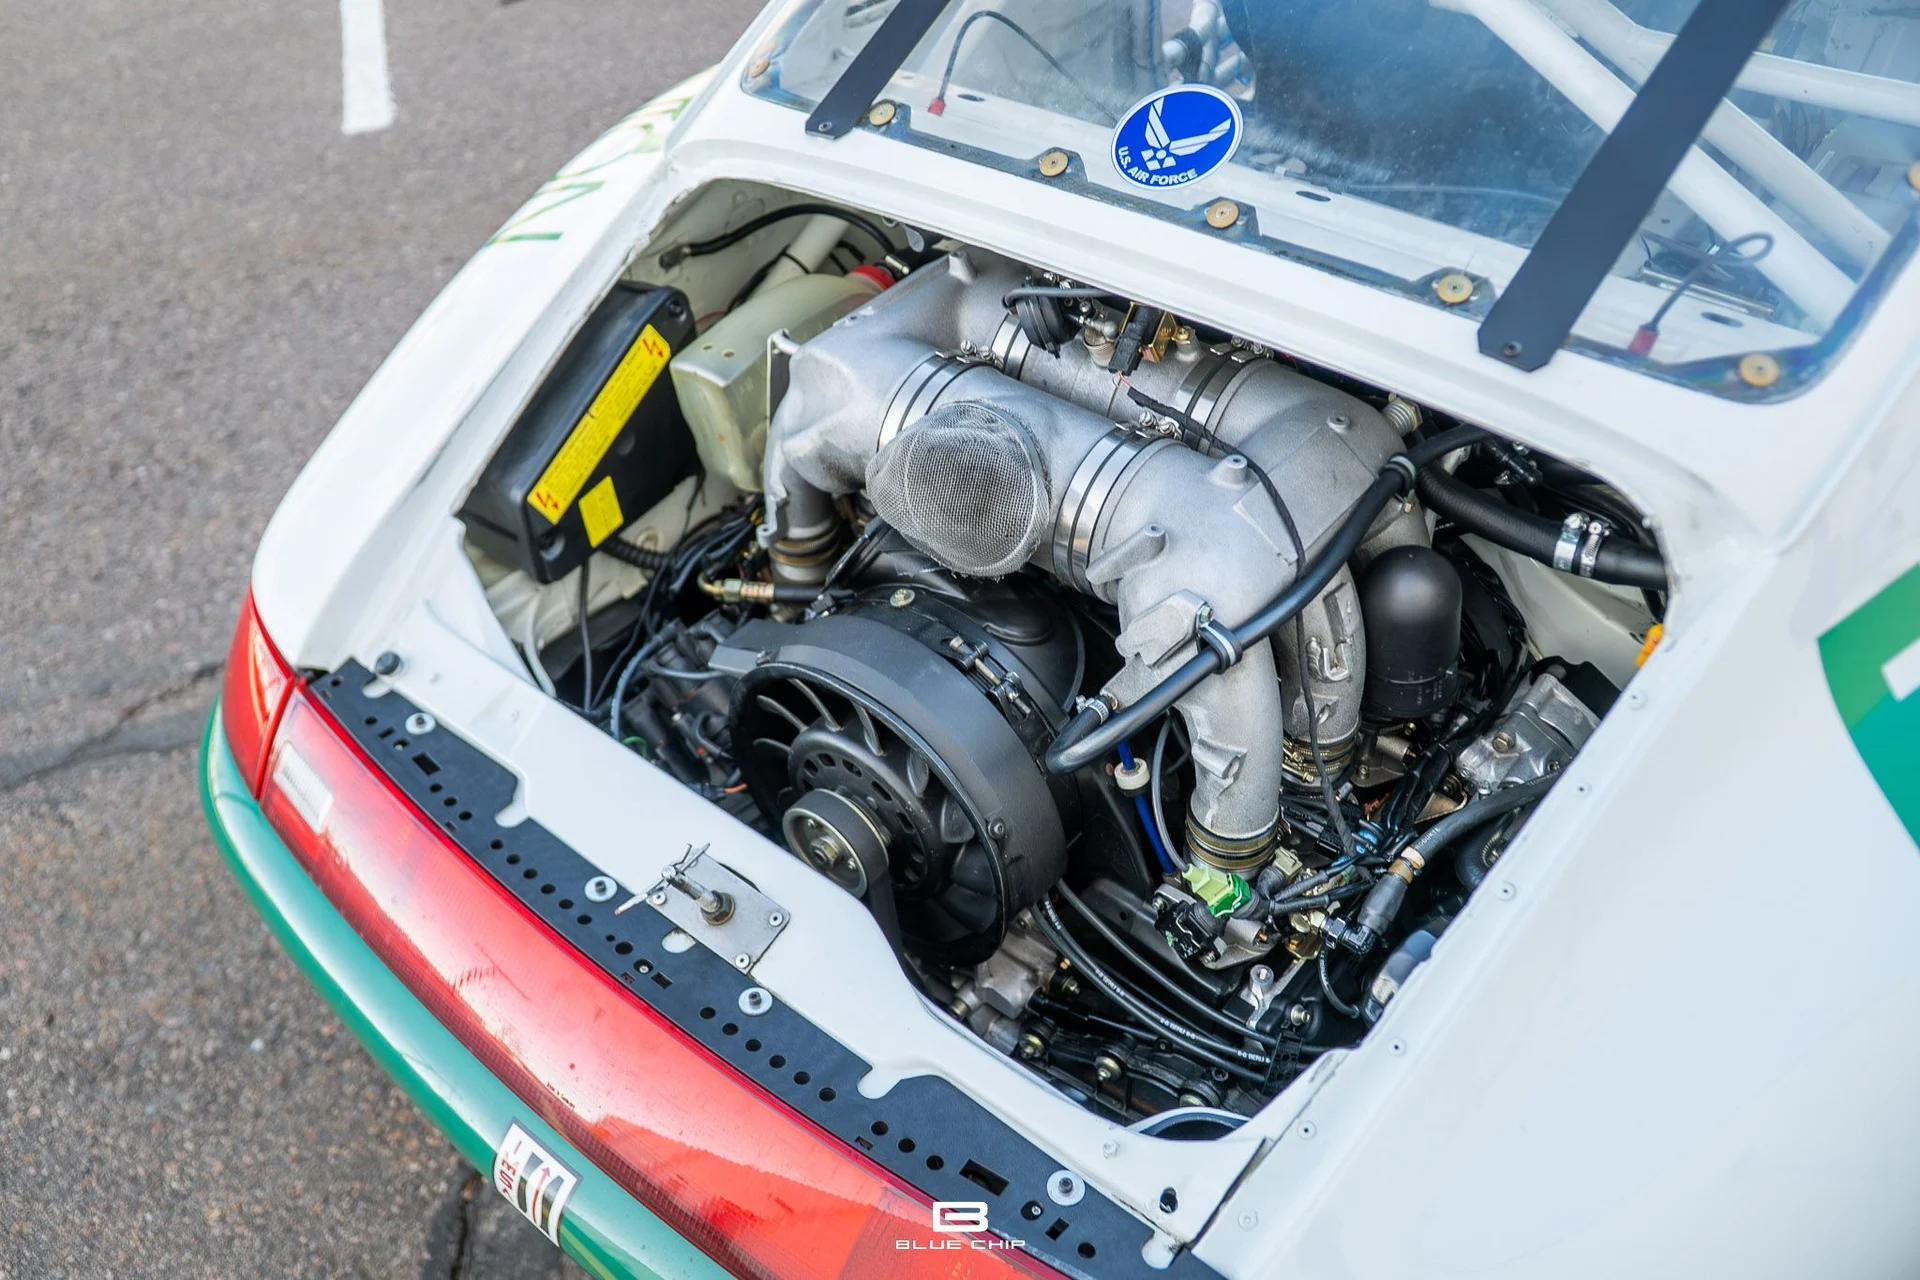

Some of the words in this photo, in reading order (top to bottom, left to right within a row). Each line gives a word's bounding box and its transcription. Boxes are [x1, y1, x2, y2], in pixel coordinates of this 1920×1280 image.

[1118, 146, 1131, 168] U.S.
[1128, 166, 1149, 182] AIR
[1151, 168, 1198, 185] FORCE
